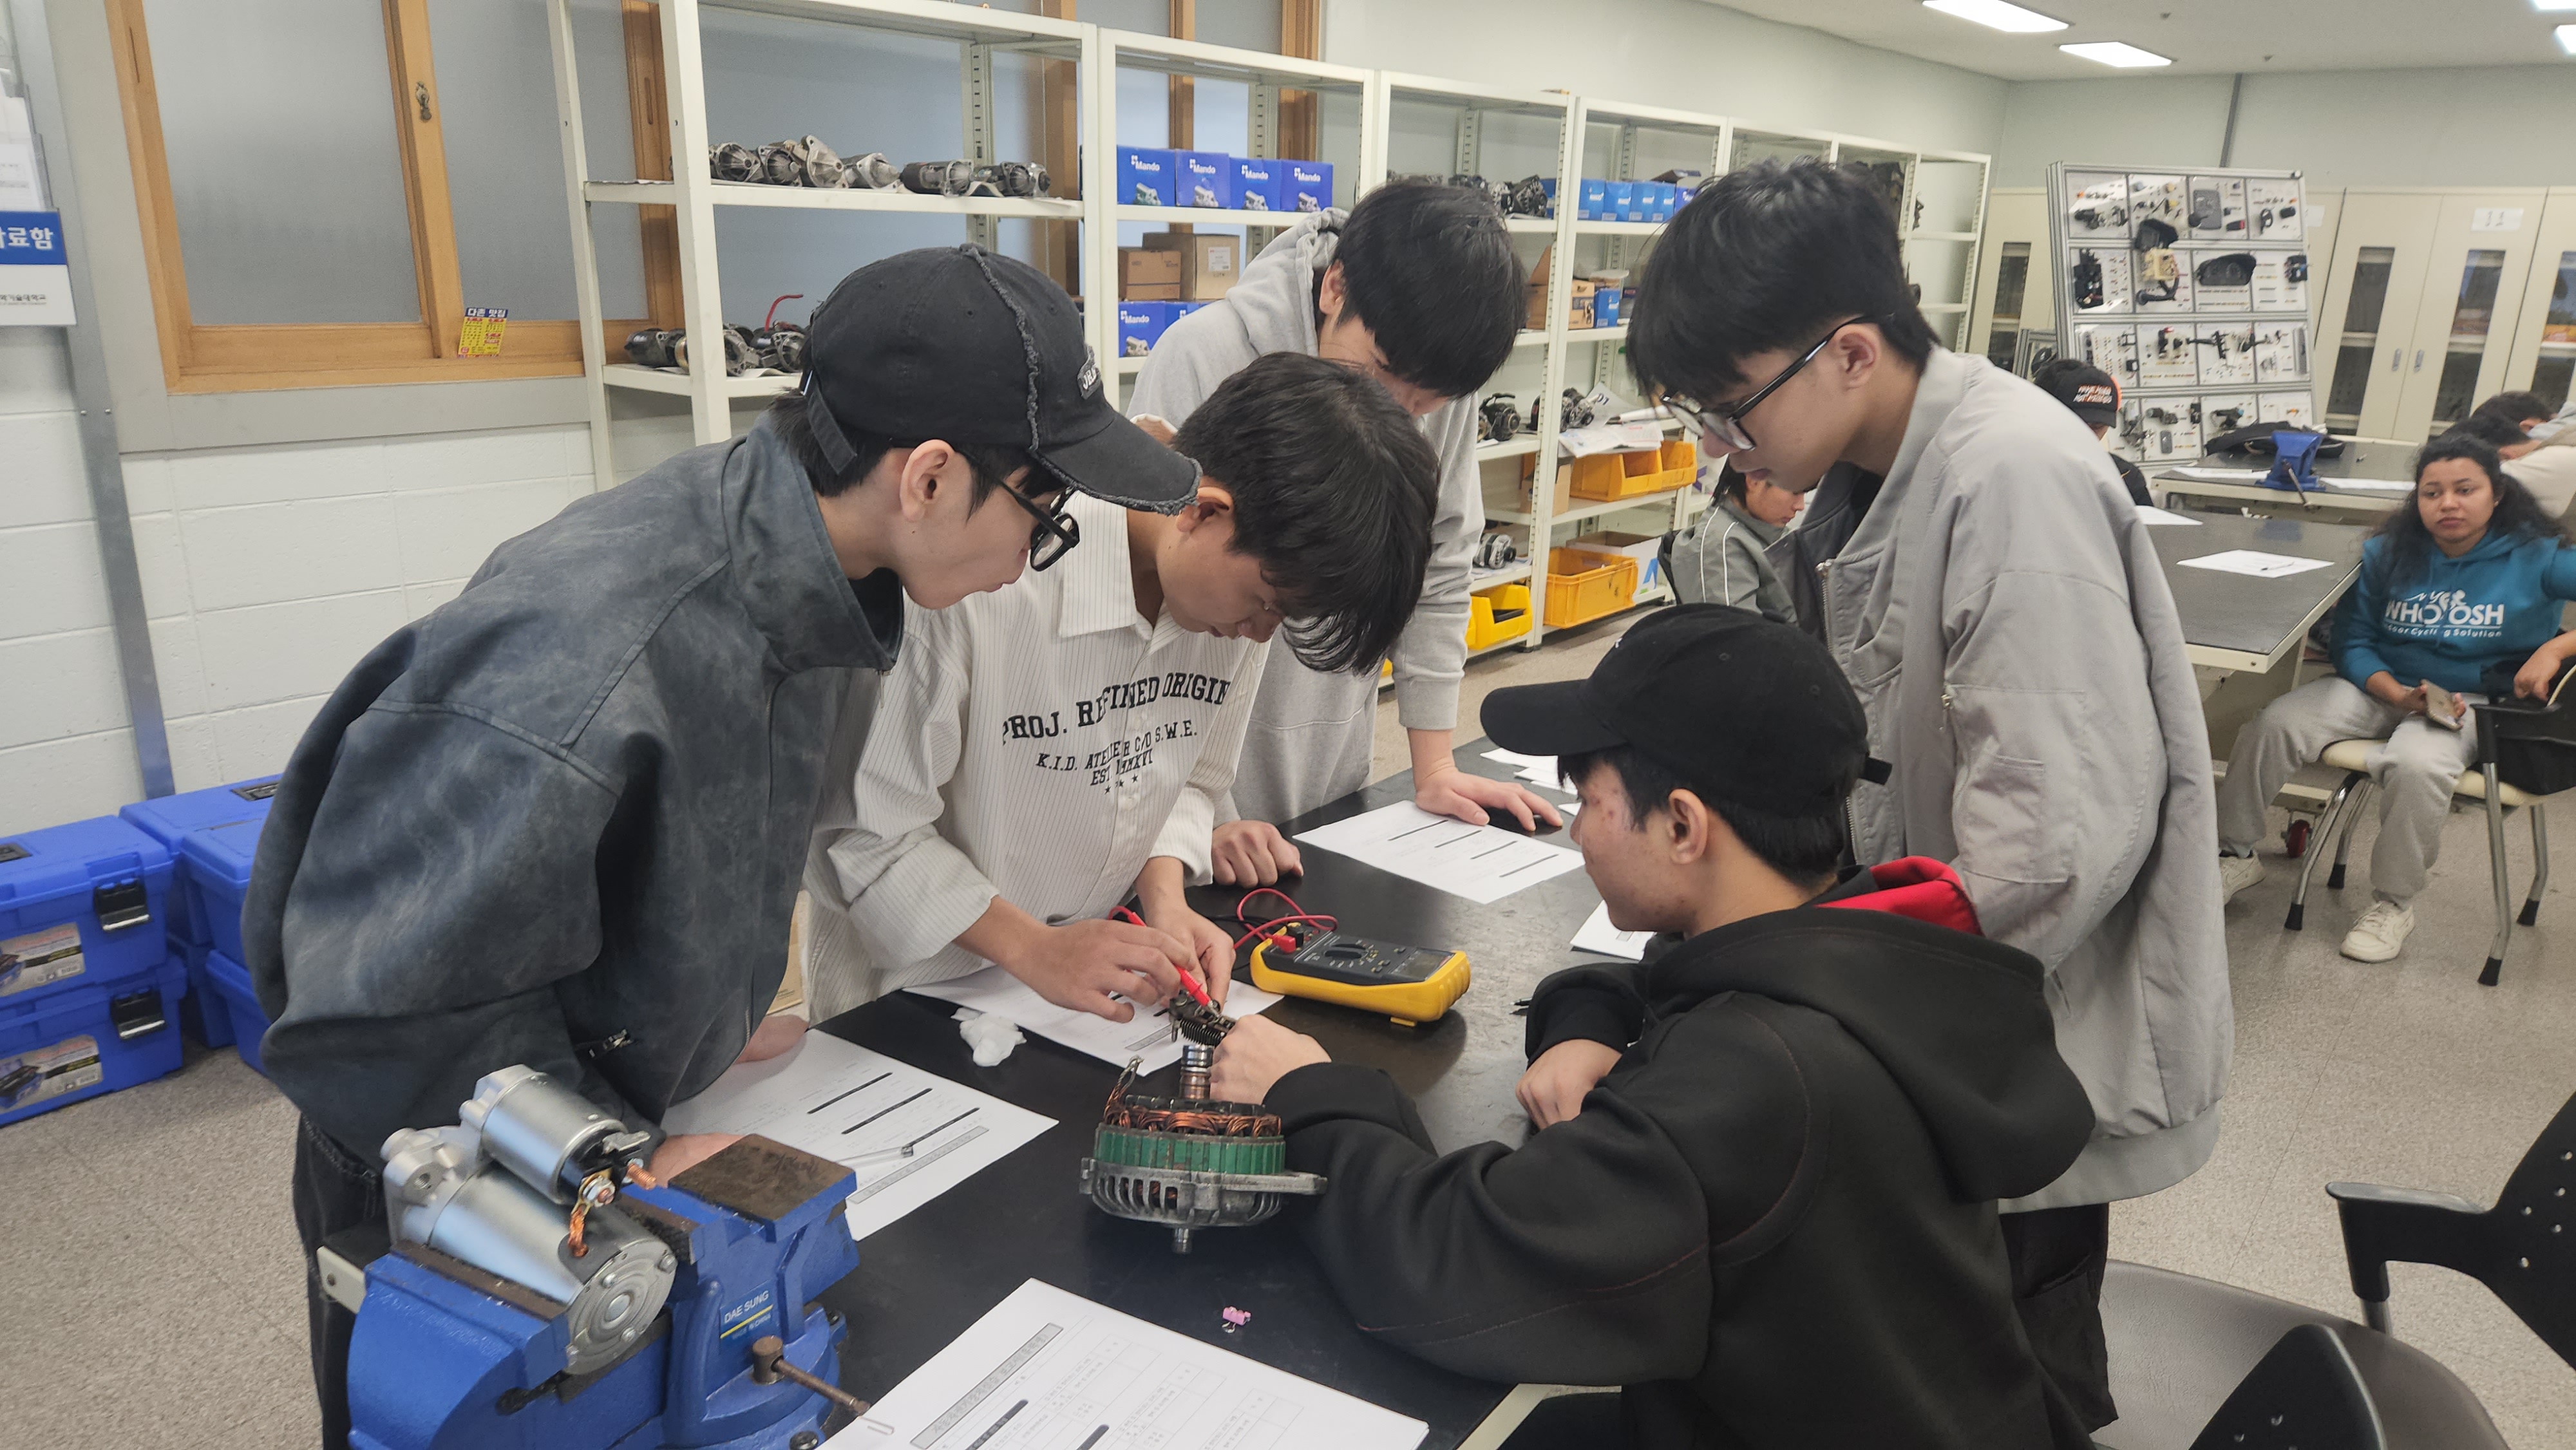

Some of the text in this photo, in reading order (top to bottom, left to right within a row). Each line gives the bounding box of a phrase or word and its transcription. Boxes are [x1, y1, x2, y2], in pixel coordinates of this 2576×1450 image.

[1135, 161, 1160, 171] Mando
[1193, 164, 1216, 174] Mando
[1245, 170, 1269, 180] Mando
[1298, 172, 1321, 182] Mando
[1124, 314, 1150, 325] Mando
[1076, 676, 1159, 727] REFINED
[1036, 753, 1077, 771] K.I.D.
[1155, 720, 1197, 742] S.W.E.
[724, 1290, 770, 1324] DAE SUNG
